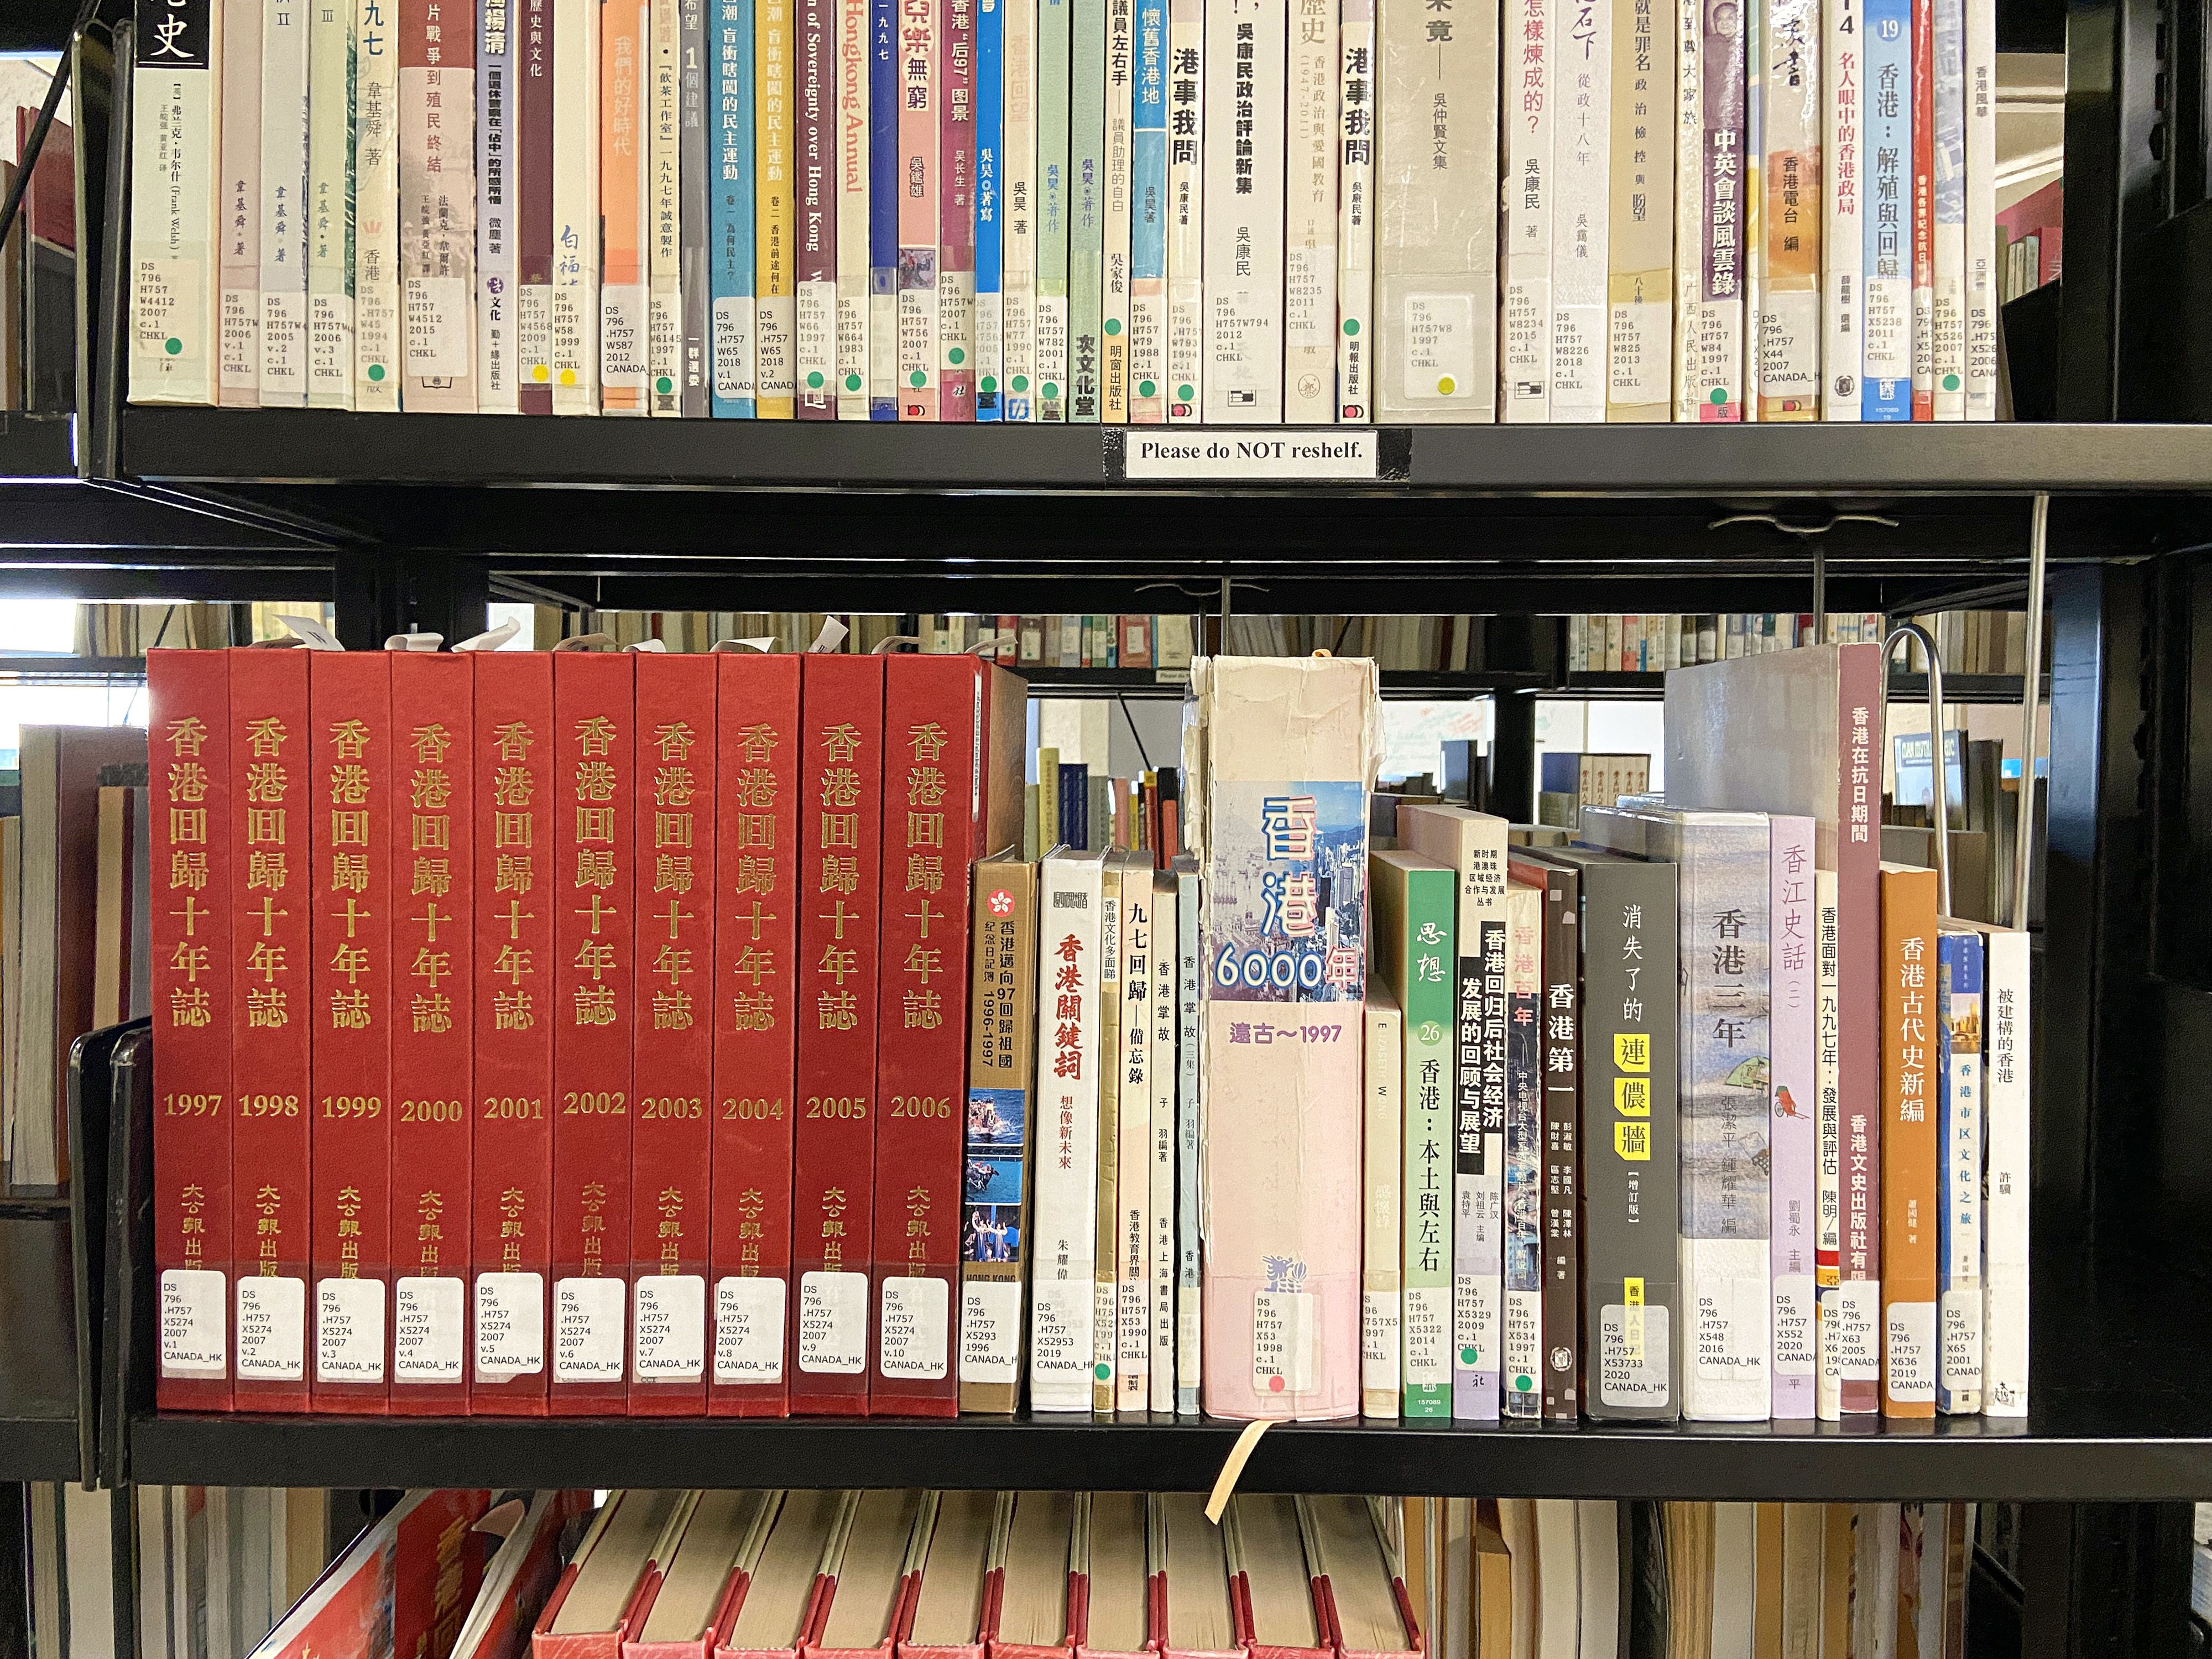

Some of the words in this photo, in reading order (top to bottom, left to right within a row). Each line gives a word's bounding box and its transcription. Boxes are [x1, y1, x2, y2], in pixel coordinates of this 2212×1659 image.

[807, 7, 821, 25] of
[1881, 20, 1898, 38] 19
[1141, 8, 1161, 105] 懷舊香港地
[805, 33, 821, 122] Sovereignty
[1172, 48, 1198, 165] 港事我問
[1235, 23, 1254, 195] 吳康民政治評論新集
[1344, 48, 1370, 165] 港事我問
[1433, 93, 1448, 169] 吳仲賢文集
[1576, 74, 1590, 167] 從政十八年
[810, 127, 821, 160] over
[1838, 52, 1855, 216] 名人眼中的香港政局
[847, 112, 864, 194] Annual
[1112, 118, 1126, 212] 議員助理的自白
[807, 166, 821, 206] Hong
[1524, 158, 1541, 209] 吳康民
[1782, 157, 1798, 223] 香港電台
[1013, 182, 1027, 211] 吳昊
[1713, 129, 1736, 296] 中英會談風雲錄
[807, 212, 821, 252] Kong
[1014, 220, 1027, 234] 著
[1525, 225, 1539, 238] 著
[1235, 227, 1251, 276] 吳康民
[1783, 236, 1798, 252] 編
[142, 262, 154, 271] DS
[1111, 254, 1123, 293] 吳家俊
[141, 285, 167, 294] H757
[142, 274, 160, 283] 796
[141, 296, 174, 306] W4412
[140, 308, 166, 317] 2007
[1217, 330, 1242, 340] 2012
[1764, 349, 1783, 358] X44
[1348, 342, 1359, 395] 明報出版社
[1764, 361, 1789, 370] 2007
[1109, 345, 1122, 410] 明窗出版社
[1141, 442, 1200, 458] Please
[1207, 442, 1230, 458] do
[1237, 442, 1285, 458] NOT
[1292, 441, 1362, 458] reshelf.
[1851, 707, 1869, 843] 香港在抗日期間
[1473, 850, 1498, 859] 新时期
[1260, 795, 1317, 938] 香港
[1473, 862, 1498, 870] 港澳珠
[1469, 874, 1501, 883] 区域经济
[1465, 885, 1505, 895] 合作与发展
[1477, 898, 1493, 906] 丛书
[1781, 844, 1807, 971] 香江史話
[1104, 900, 1116, 979] 香港文化多面睇
[1417, 922, 1447, 982] 思想
[1623, 904, 1644, 1022] 消失了的
[1215, 942, 1357, 990] 6000年
[1514, 925, 1534, 1026] 香港百年
[1712, 909, 1748, 1048] 香港三年
[1054, 934, 1084, 1080] 香港關鍵詞
[1158, 962, 1170, 1041] 香港掌故
[1183, 956, 1196, 1039] 香港掌故
[983, 992, 994, 1067] 1996-1997
[1420, 1024, 1440, 1042] 26
[1483, 929, 1506, 1129] 香港回归后社会经济
[1548, 983, 1574, 1092] 香港第一
[1900, 937, 1926, 1123] 香港古代史新編
[1997, 989, 2013, 1083] 被建構的香港
[1459, 977, 1483, 1154] 发展的回顾与展望
[164, 1094, 223, 1117] 1997
[239, 1095, 300, 1117] 1998
[322, 1096, 382, 1118] 1999
[400, 1100, 463, 1123] 2000
[483, 1097, 544, 1119] 2001
[563, 1092, 626, 1114] 2002
[641, 1097, 703, 1119] 2003
[722, 1098, 784, 1120] 2004
[806, 1097, 867, 1119] 2005
[890, 1096, 951, 1118] 2006
[1058, 1095, 1073, 1169] 想像新未來
[1959, 1065, 1971, 1224] 香港市区文化之旅
[1476, 1225, 1485, 1242] 主编
[1721, 1218, 1736, 1234] 編
[164, 1284, 176, 1292] DS
[164, 1295, 181, 1303] 796
[164, 1318, 193, 1326] X5274
[164, 1340, 177, 1349] v.1
[1037, 1337, 1073, 1345] X52953
[1257, 1332, 1275, 1340] X53
[1699, 1333, 1724, 1341] X548
[164, 1352, 222, 1362] CANADA_HK
[1257, 1343, 1282, 1352] 1998
[1699, 1344, 1723, 1353] 2016
[1256, 1366, 1283, 1374] CHKL
[1604, 1359, 1642, 1367] X53733
[1605, 1371, 1630, 1379] 2020
[1604, 1382, 1667, 1392] CANADA_HK
